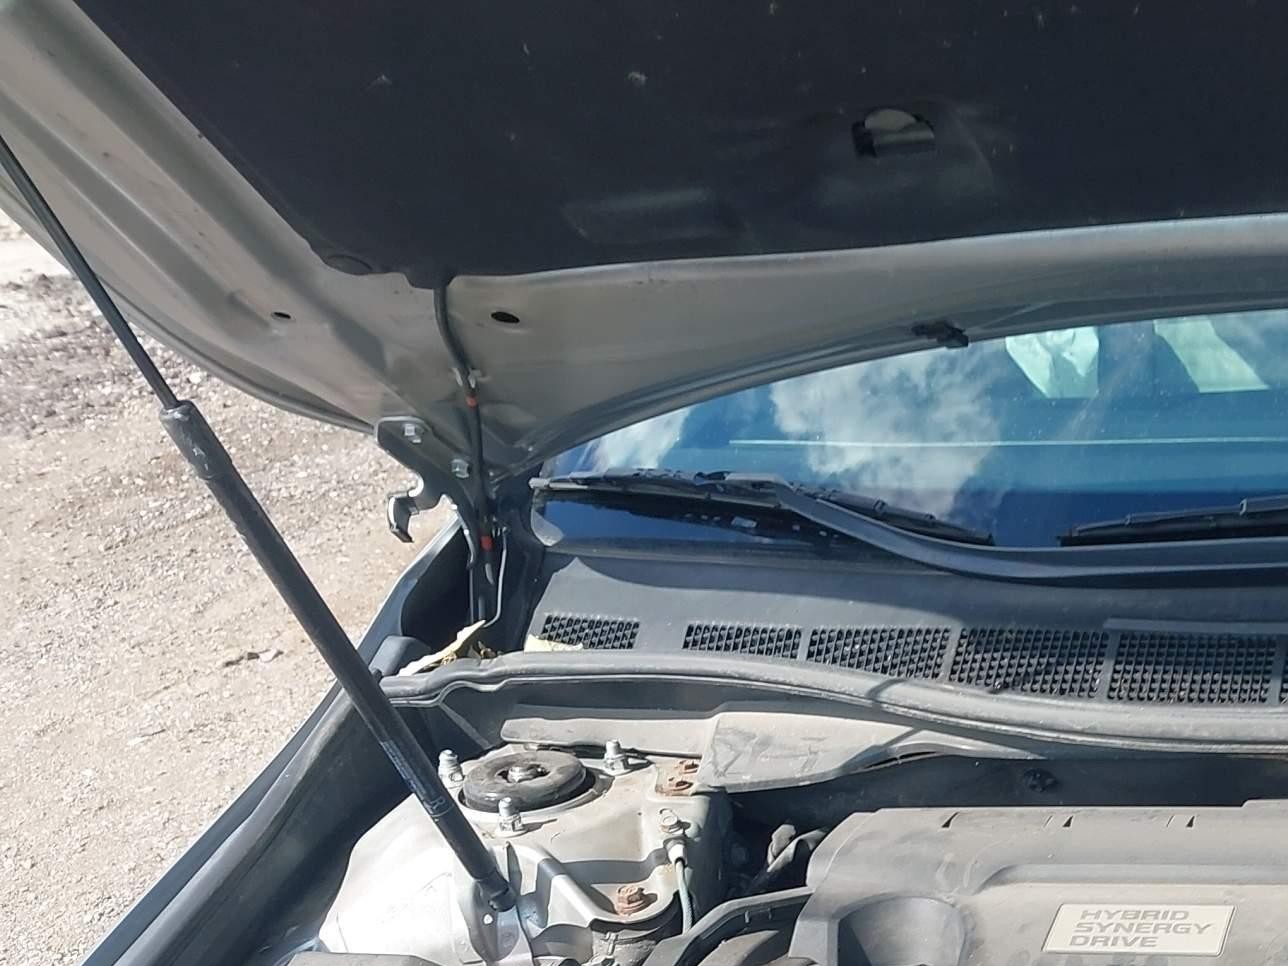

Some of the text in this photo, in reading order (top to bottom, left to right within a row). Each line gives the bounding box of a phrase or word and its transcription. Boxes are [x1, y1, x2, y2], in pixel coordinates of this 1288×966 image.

[1080, 909, 1189, 920] HYBRID
[1073, 922, 1212, 934] SYNERGY
[1069, 936, 1159, 947] DRIVE
